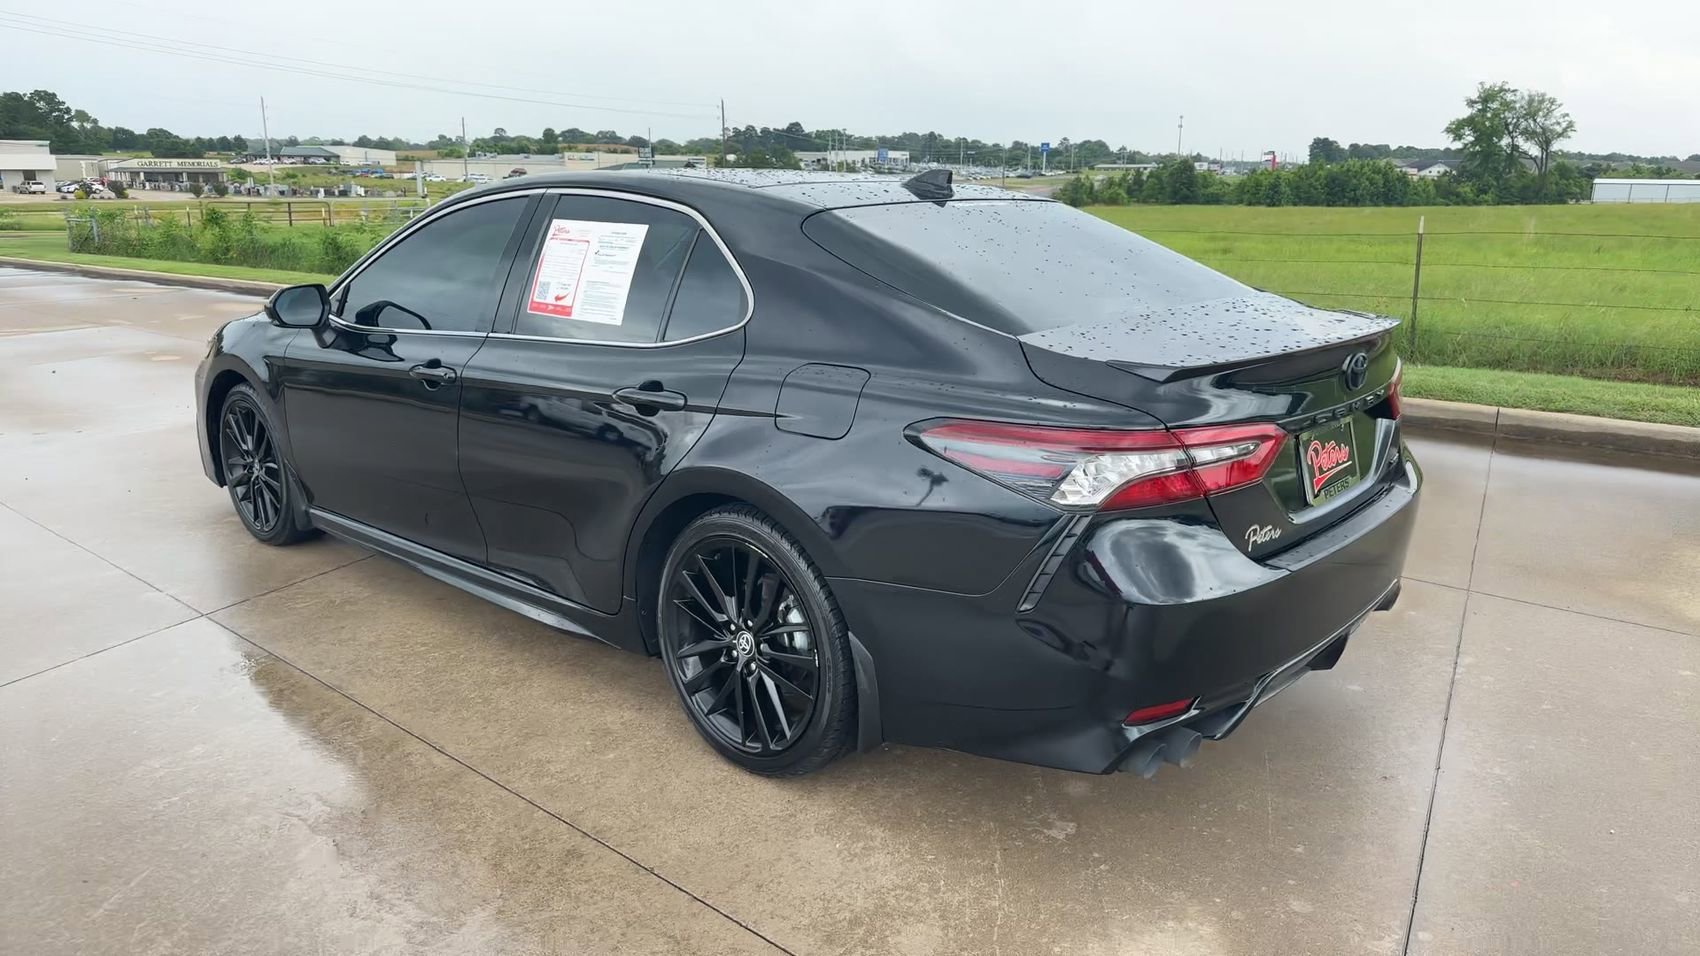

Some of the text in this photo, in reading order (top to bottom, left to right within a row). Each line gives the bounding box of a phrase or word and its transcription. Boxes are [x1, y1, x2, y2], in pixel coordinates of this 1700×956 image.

[1306, 440, 1350, 477] Peters
[1323, 478, 1351, 499] PETERS
[1244, 523, 1282, 552] Peters
